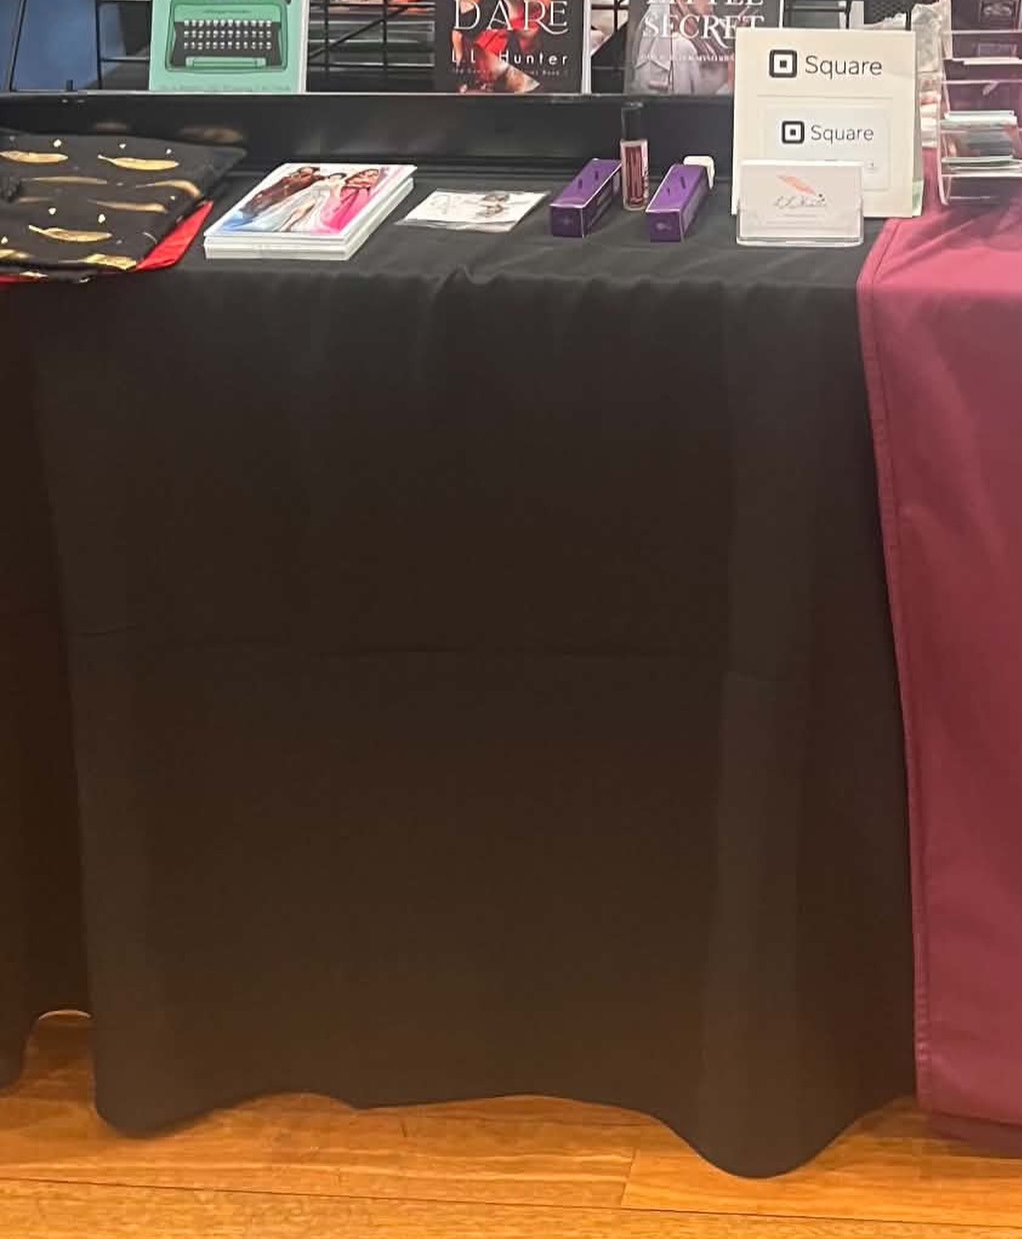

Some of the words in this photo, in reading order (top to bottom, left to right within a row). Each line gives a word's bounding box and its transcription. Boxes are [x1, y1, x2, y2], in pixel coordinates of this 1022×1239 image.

[499, 49, 568, 65] Hunter
[805, 55, 883, 80] Square
[810, 125, 875, 145] Square
